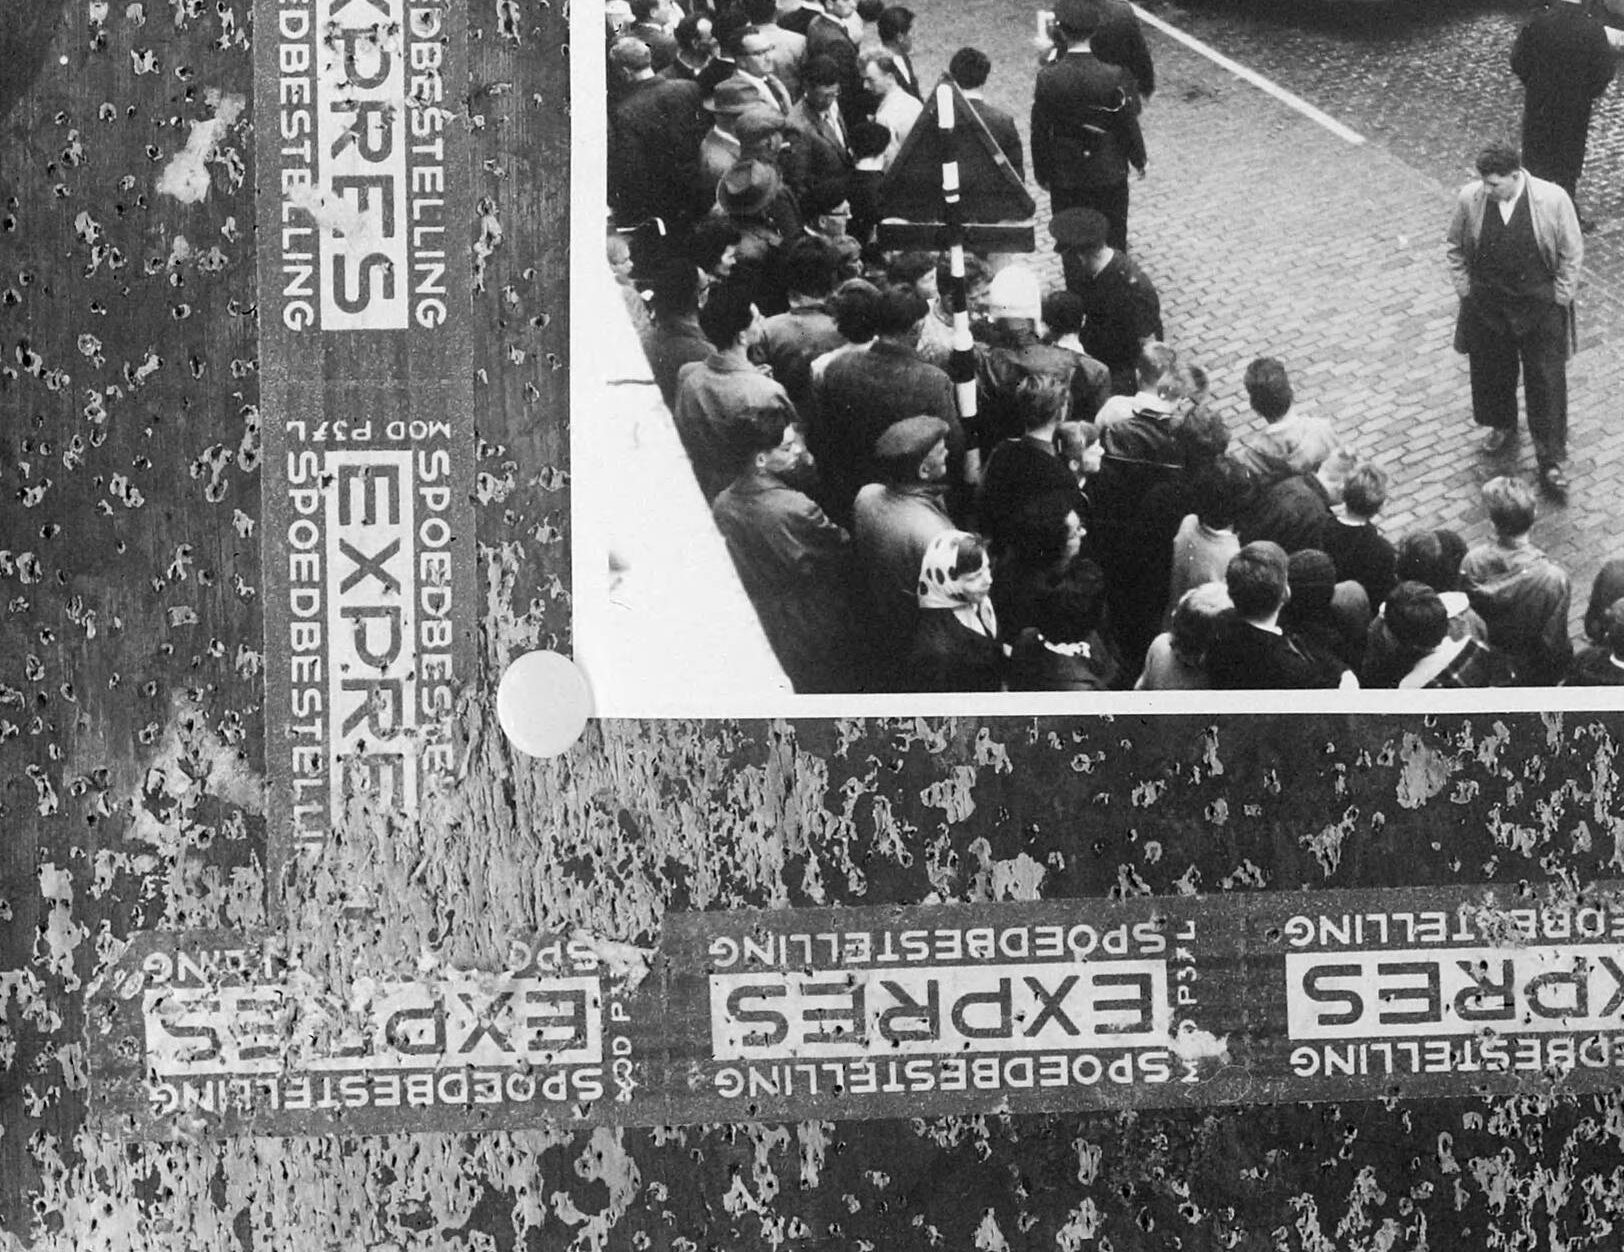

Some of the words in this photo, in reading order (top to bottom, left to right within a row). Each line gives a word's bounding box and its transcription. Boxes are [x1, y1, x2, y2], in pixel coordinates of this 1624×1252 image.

[387, 420, 451, 440] MOD
[338, 465, 401, 810] EXPRE
[708, 922, 1167, 967] SPOEDBESTELLING
[726, 973, 1153, 1047] EXPRES
[713, 1052, 1169, 1098] SPOEDBESTELLING
[1178, 1019, 1200, 1083] MD
